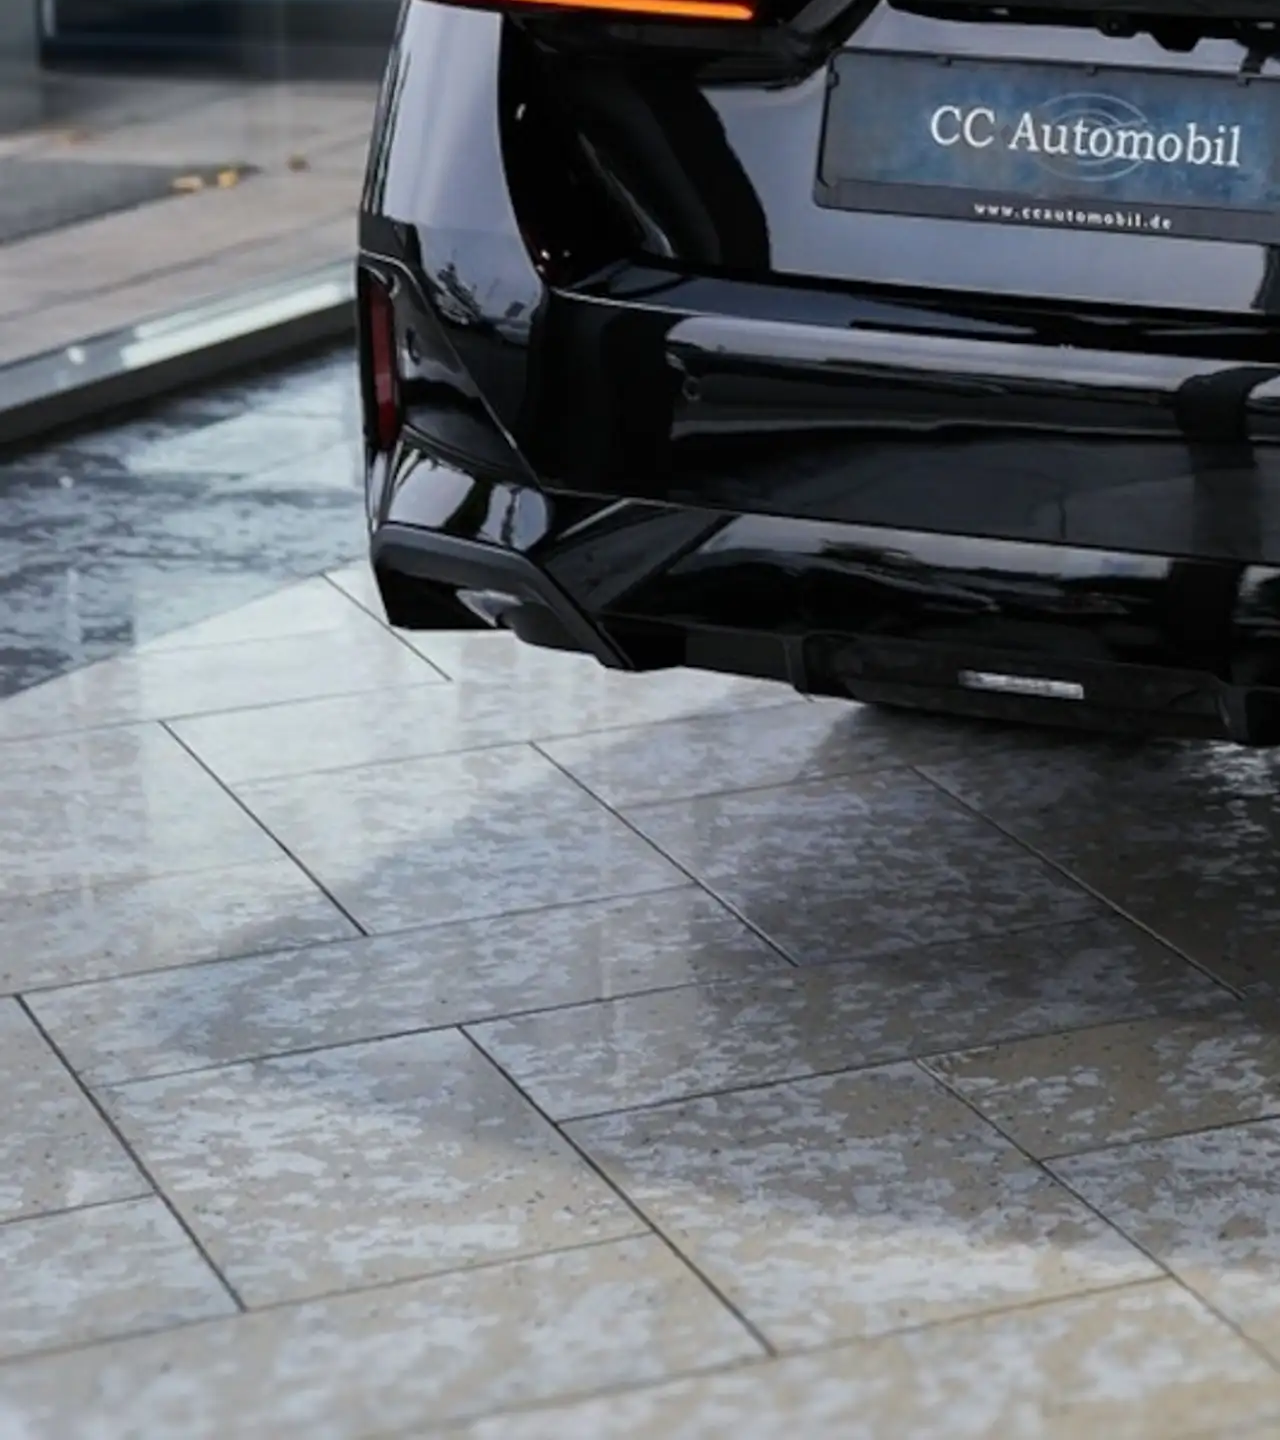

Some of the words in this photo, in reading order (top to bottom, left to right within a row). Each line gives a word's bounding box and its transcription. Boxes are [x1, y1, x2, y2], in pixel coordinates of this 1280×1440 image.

[930, 105, 996, 147] CC
[1008, 112, 1241, 167] Automobil
[973, 201, 1173, 231] www.ccautomobil.de
